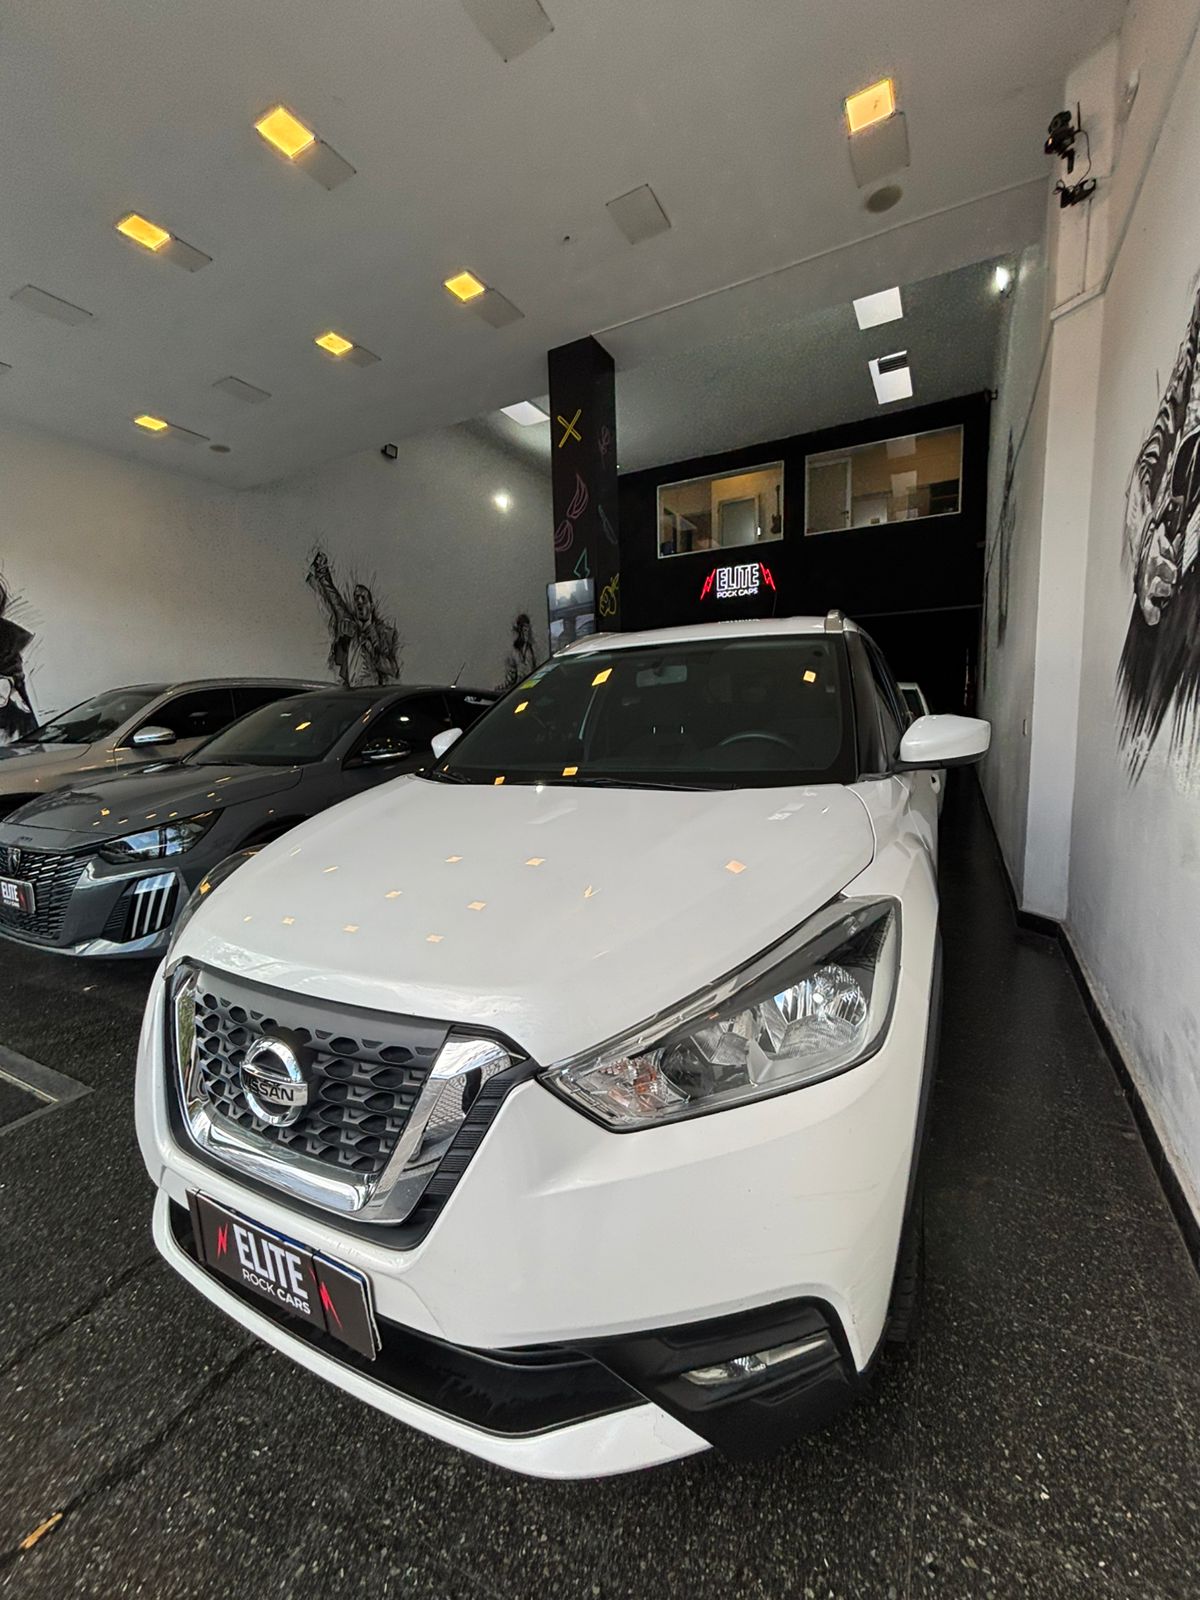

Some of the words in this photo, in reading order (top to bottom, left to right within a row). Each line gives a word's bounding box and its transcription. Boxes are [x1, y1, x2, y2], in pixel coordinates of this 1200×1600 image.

[716, 563, 760, 592] ELITE
[233, 1223, 308, 1300] ELITE
[242, 1268, 276, 1296] ROCK
[276, 1288, 312, 1315] CARS
